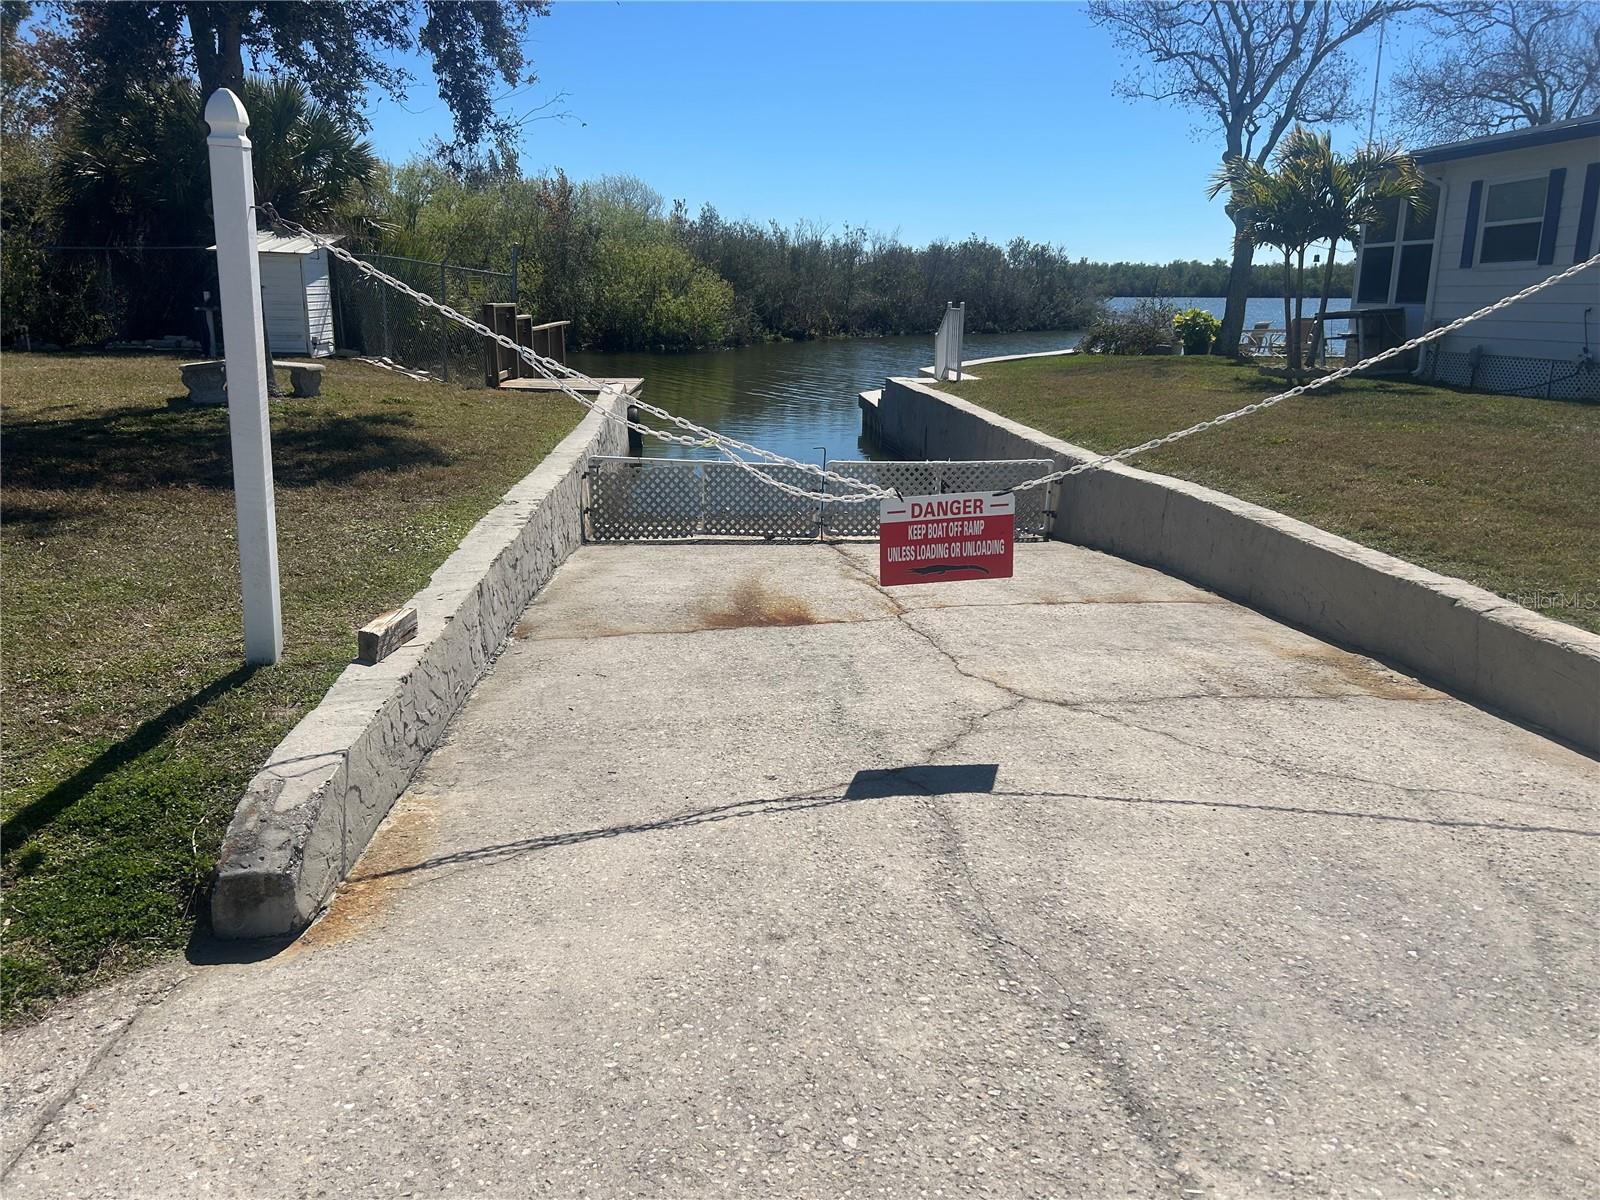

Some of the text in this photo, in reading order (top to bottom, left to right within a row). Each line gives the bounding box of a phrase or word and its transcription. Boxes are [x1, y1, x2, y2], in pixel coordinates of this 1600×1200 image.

[911, 499, 984, 518] DANGER
[908, 520, 985, 540] KEEP BOAT OFF RAMP
[887, 539, 1005, 562] UNLESS LOADING OR UNLOADING
